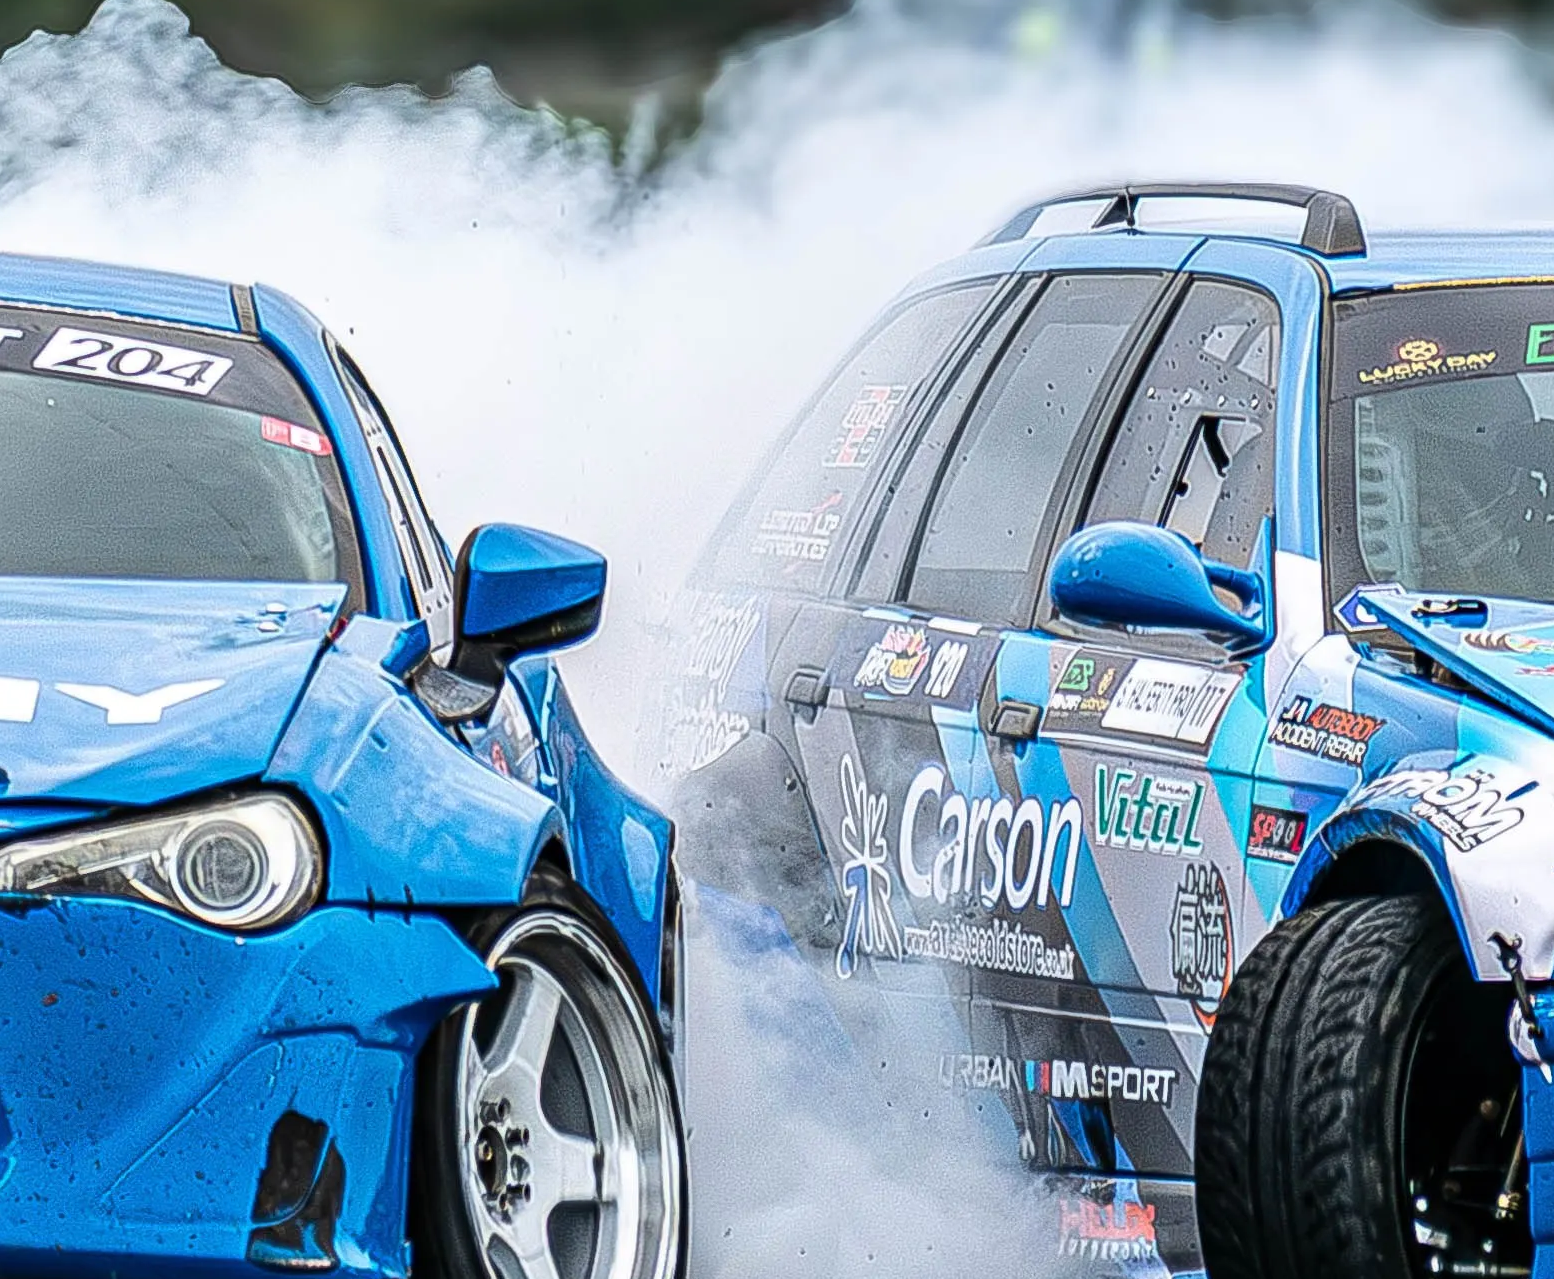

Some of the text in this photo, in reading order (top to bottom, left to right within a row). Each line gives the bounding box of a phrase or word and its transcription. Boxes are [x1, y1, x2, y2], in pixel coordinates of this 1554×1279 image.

[53, 338, 207, 386] 204
[1359, 351, 1497, 383] LUCKY DAY
[898, 765, 1084, 910] Carson
[1097, 767, 1205, 849] Vital
